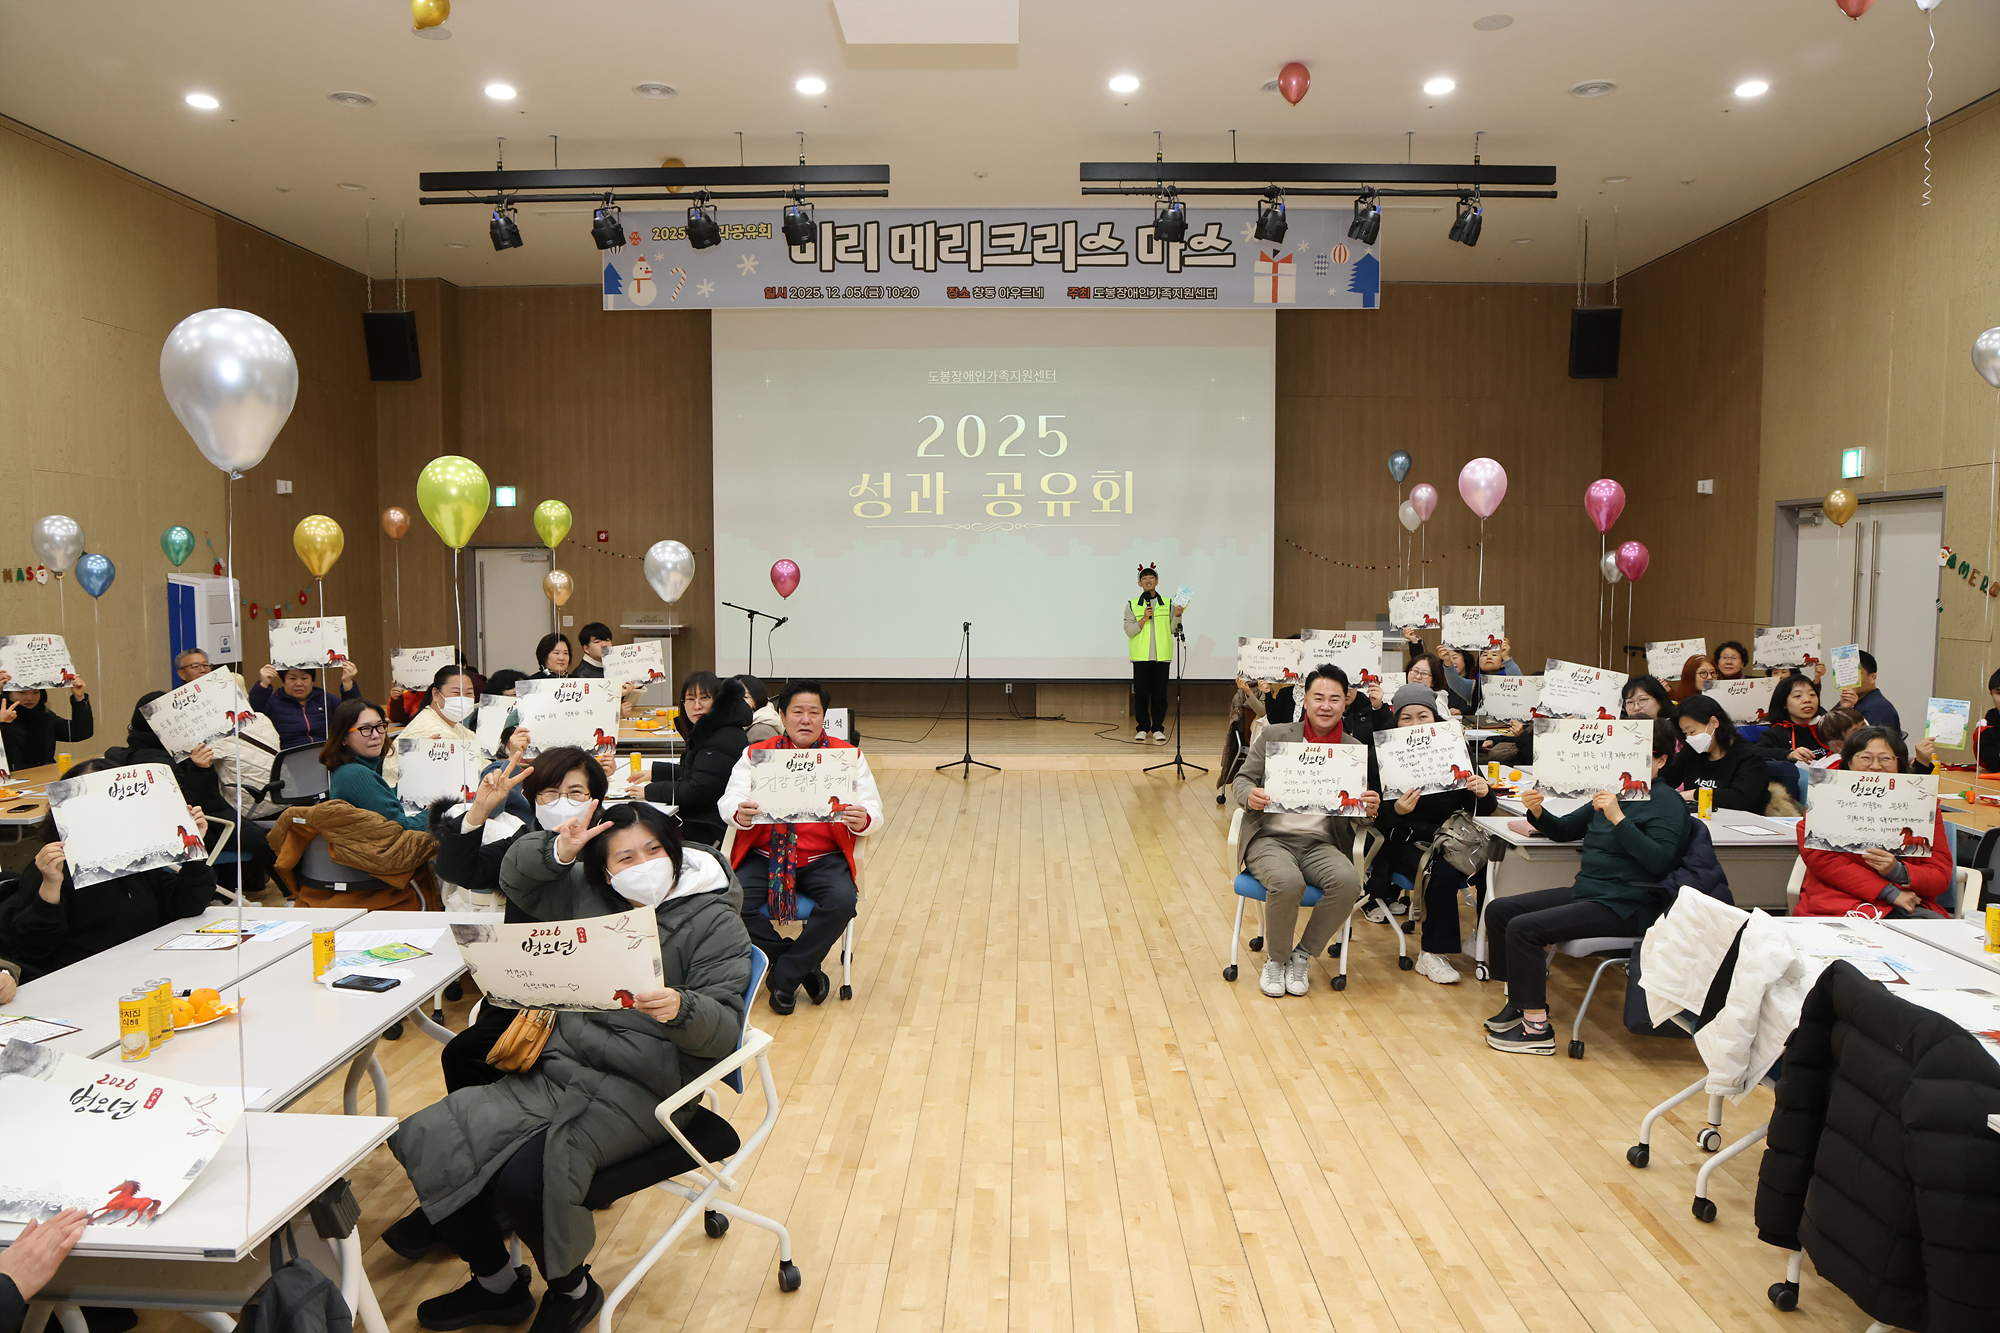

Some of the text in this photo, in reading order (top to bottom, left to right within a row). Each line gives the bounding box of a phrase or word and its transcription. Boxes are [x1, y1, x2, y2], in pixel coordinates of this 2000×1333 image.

[788, 220, 881, 273] 미리
[764, 287, 787, 299] 일시
[789, 287, 823, 299] 2025.
[826, 287, 840, 299] 12
[886, 287, 920, 299] 10:20
[946, 286, 1045, 299] 장소 창동 아우르네
[1067, 286, 1218, 300] 주최 도봉장애인가족지원센터
[928, 369, 1056, 383] 도봉장애인가족지원센터
[917, 414, 1068, 458] 2025
[849, 470, 1134, 518] 성과 공유회
[560, 681, 578, 689] 2026
[554, 688, 584, 703] 병오년
[1410, 727, 1424, 735] 2026
[1572, 730, 1606, 745] 병오년
[1406, 735, 1432, 748] 병오년
[786, 759, 816, 772] 병오년
[1298, 752, 1327, 766] 병오년
[113, 769, 138, 781] 2026
[1860, 775, 1880, 783] 2026
[108, 780, 149, 801] 병오년
[794, 772, 818, 795] 행복
[823, 773, 851, 794] 함께
[1851, 781, 1887, 797] 병오년
[530, 926, 562, 938] 2026
[521, 937, 578, 957] 병오년
[96, 1073, 139, 1091] 2026
[69, 1083, 139, 1120] 병오년
